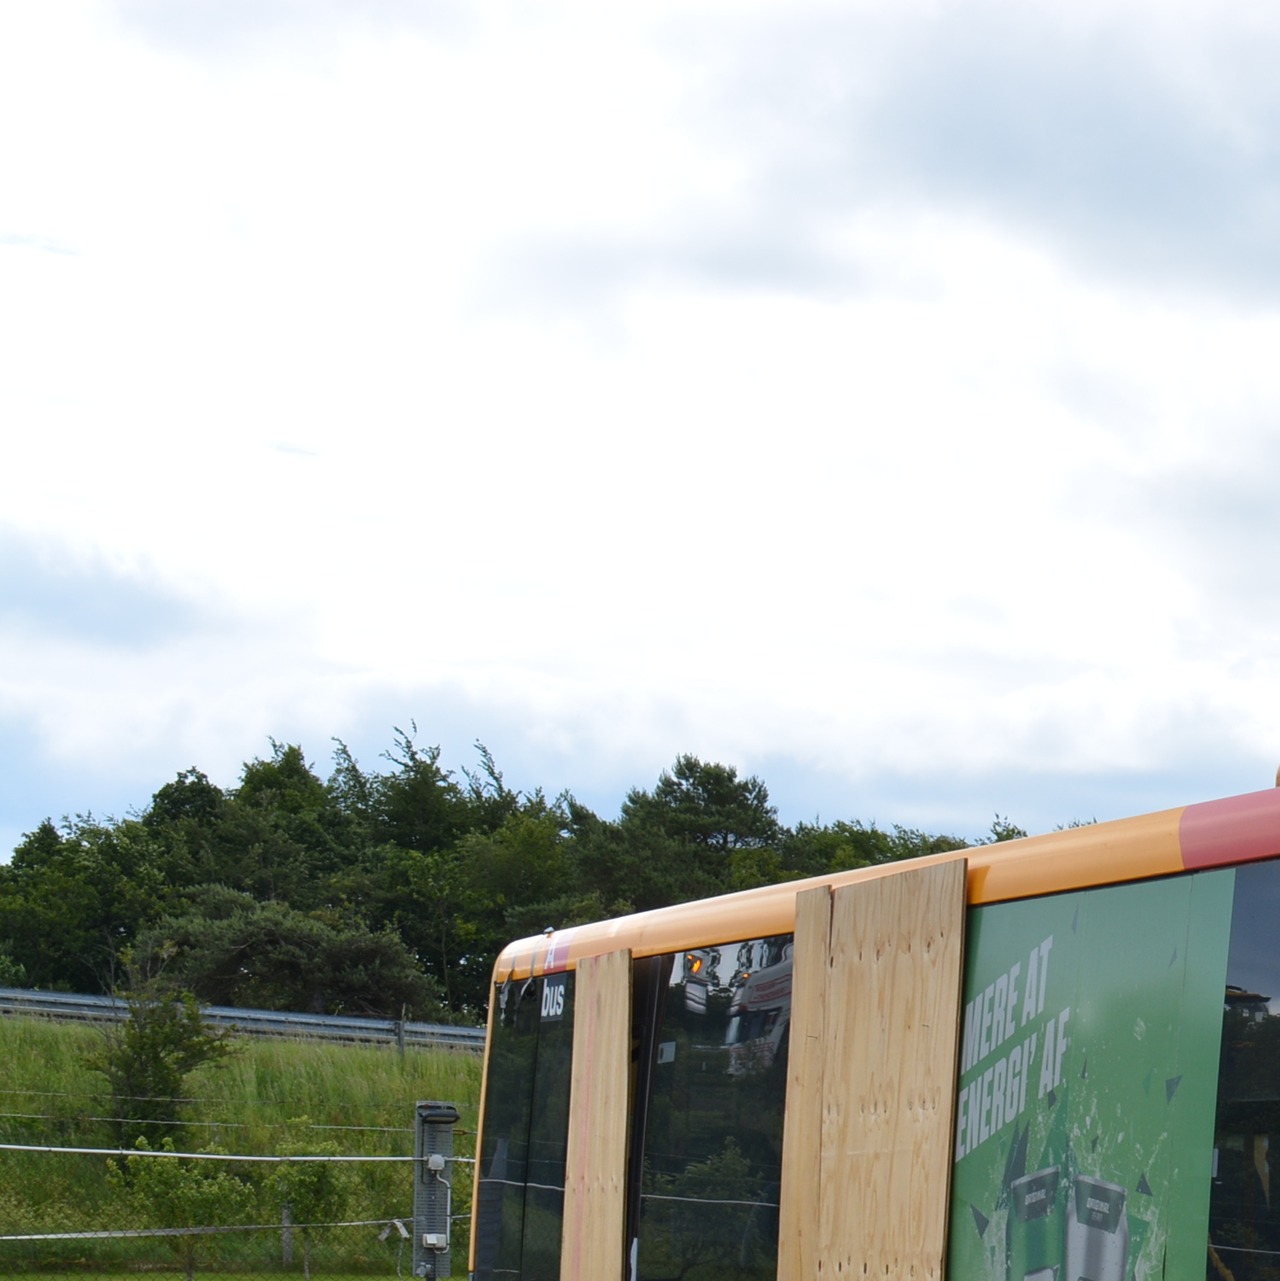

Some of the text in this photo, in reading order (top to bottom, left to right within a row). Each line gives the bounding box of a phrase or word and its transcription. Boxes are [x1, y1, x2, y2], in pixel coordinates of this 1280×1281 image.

[541, 978, 565, 1017] bus
[961, 934, 1054, 1076] MERE AT
[1038, 1006, 1071, 1100] AF
